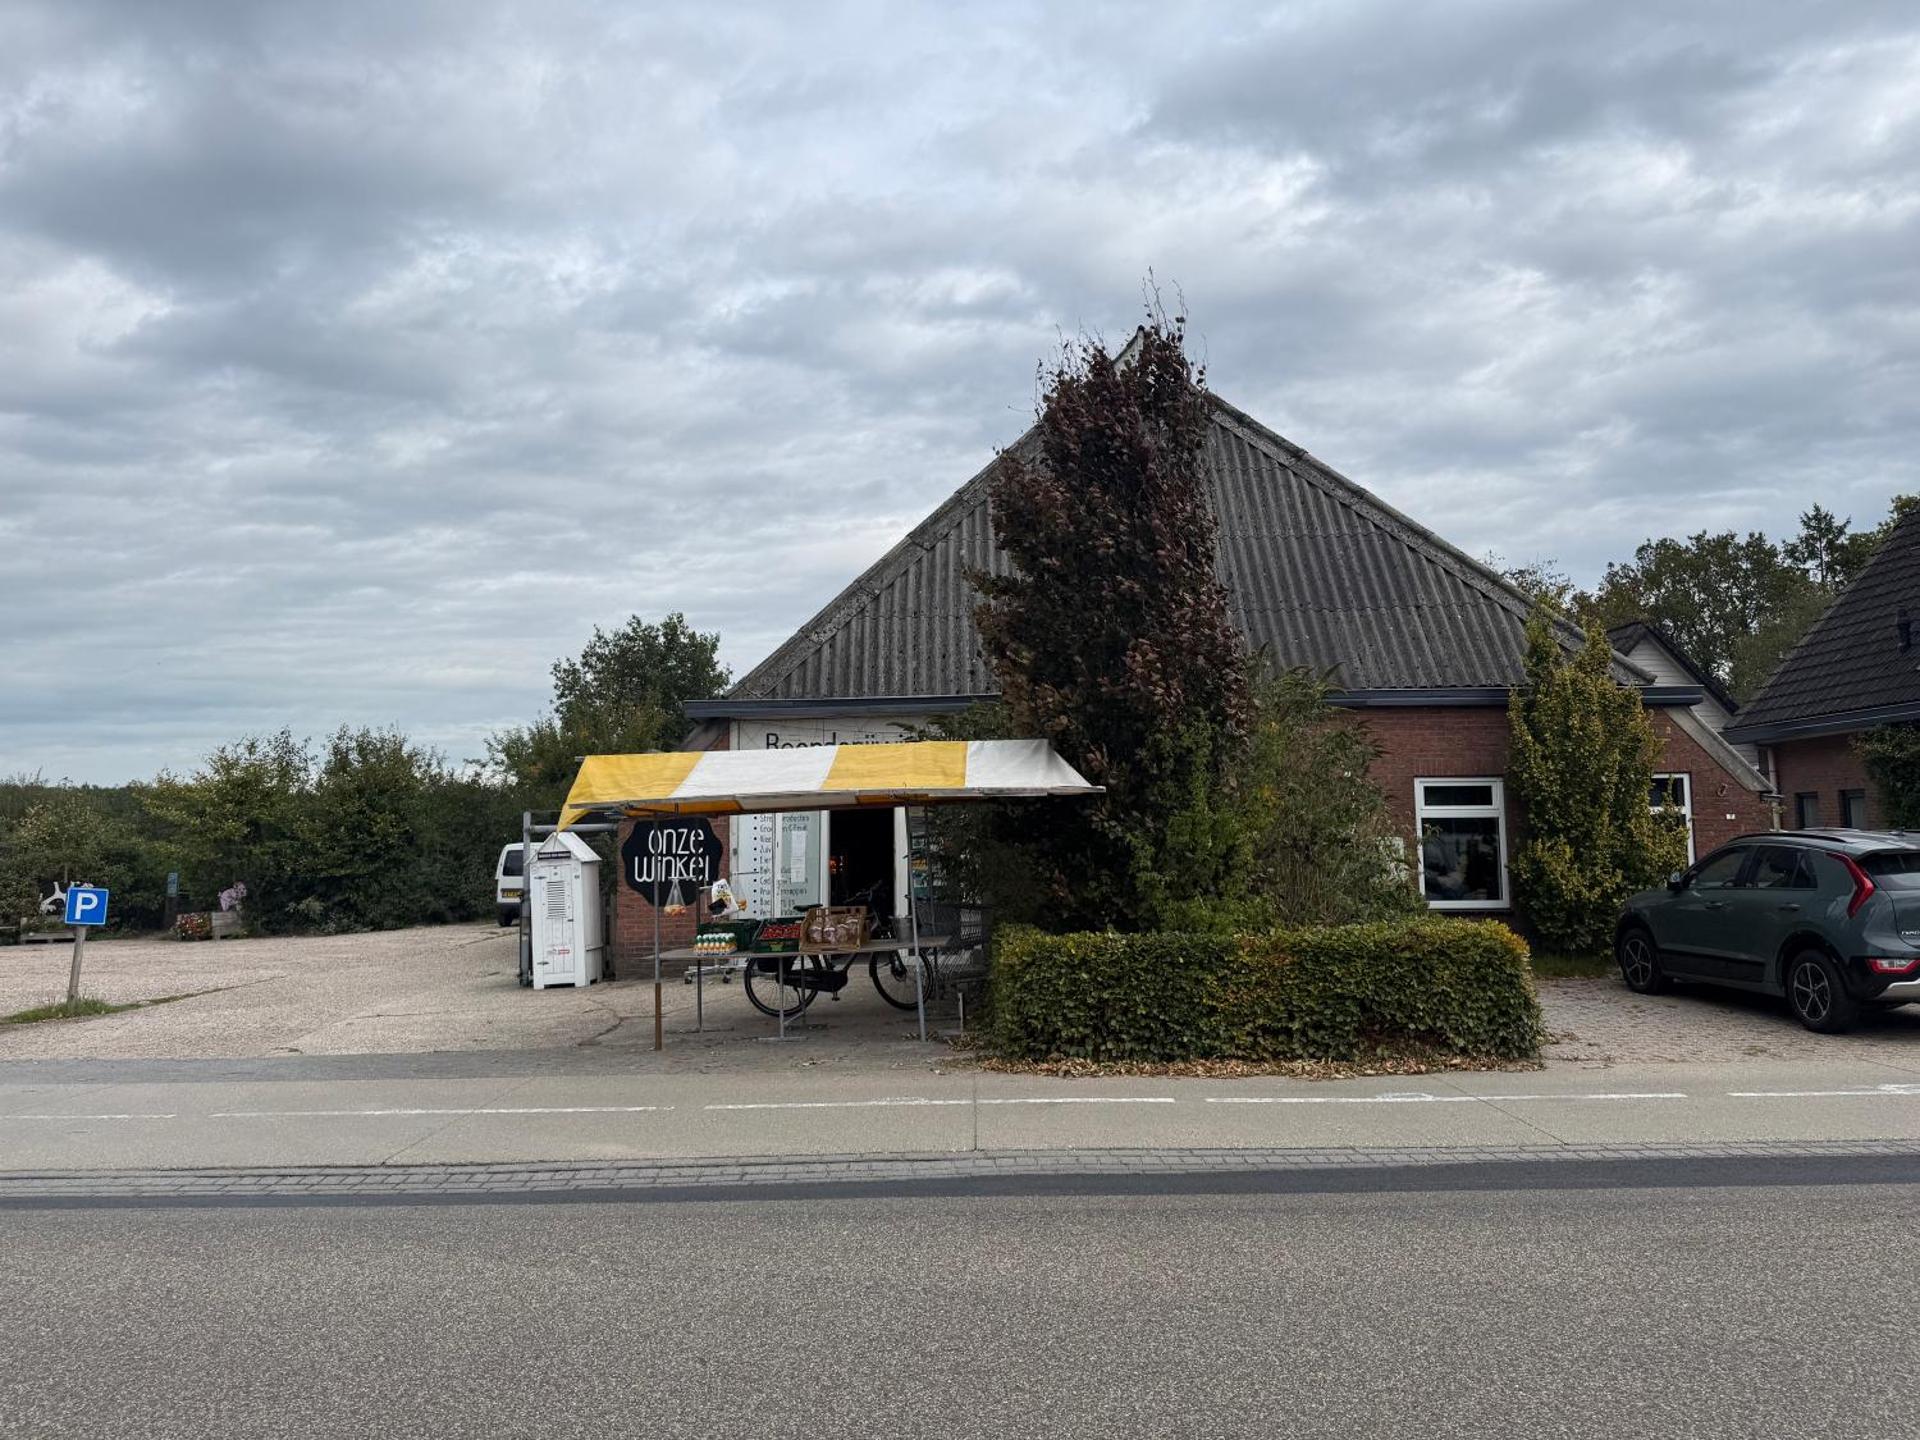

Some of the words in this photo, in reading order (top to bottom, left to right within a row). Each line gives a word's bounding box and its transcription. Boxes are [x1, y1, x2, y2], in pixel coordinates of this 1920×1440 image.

[648, 828, 705, 855] onze
[634, 855, 709, 883] winkel
[74, 892, 98, 920] P
